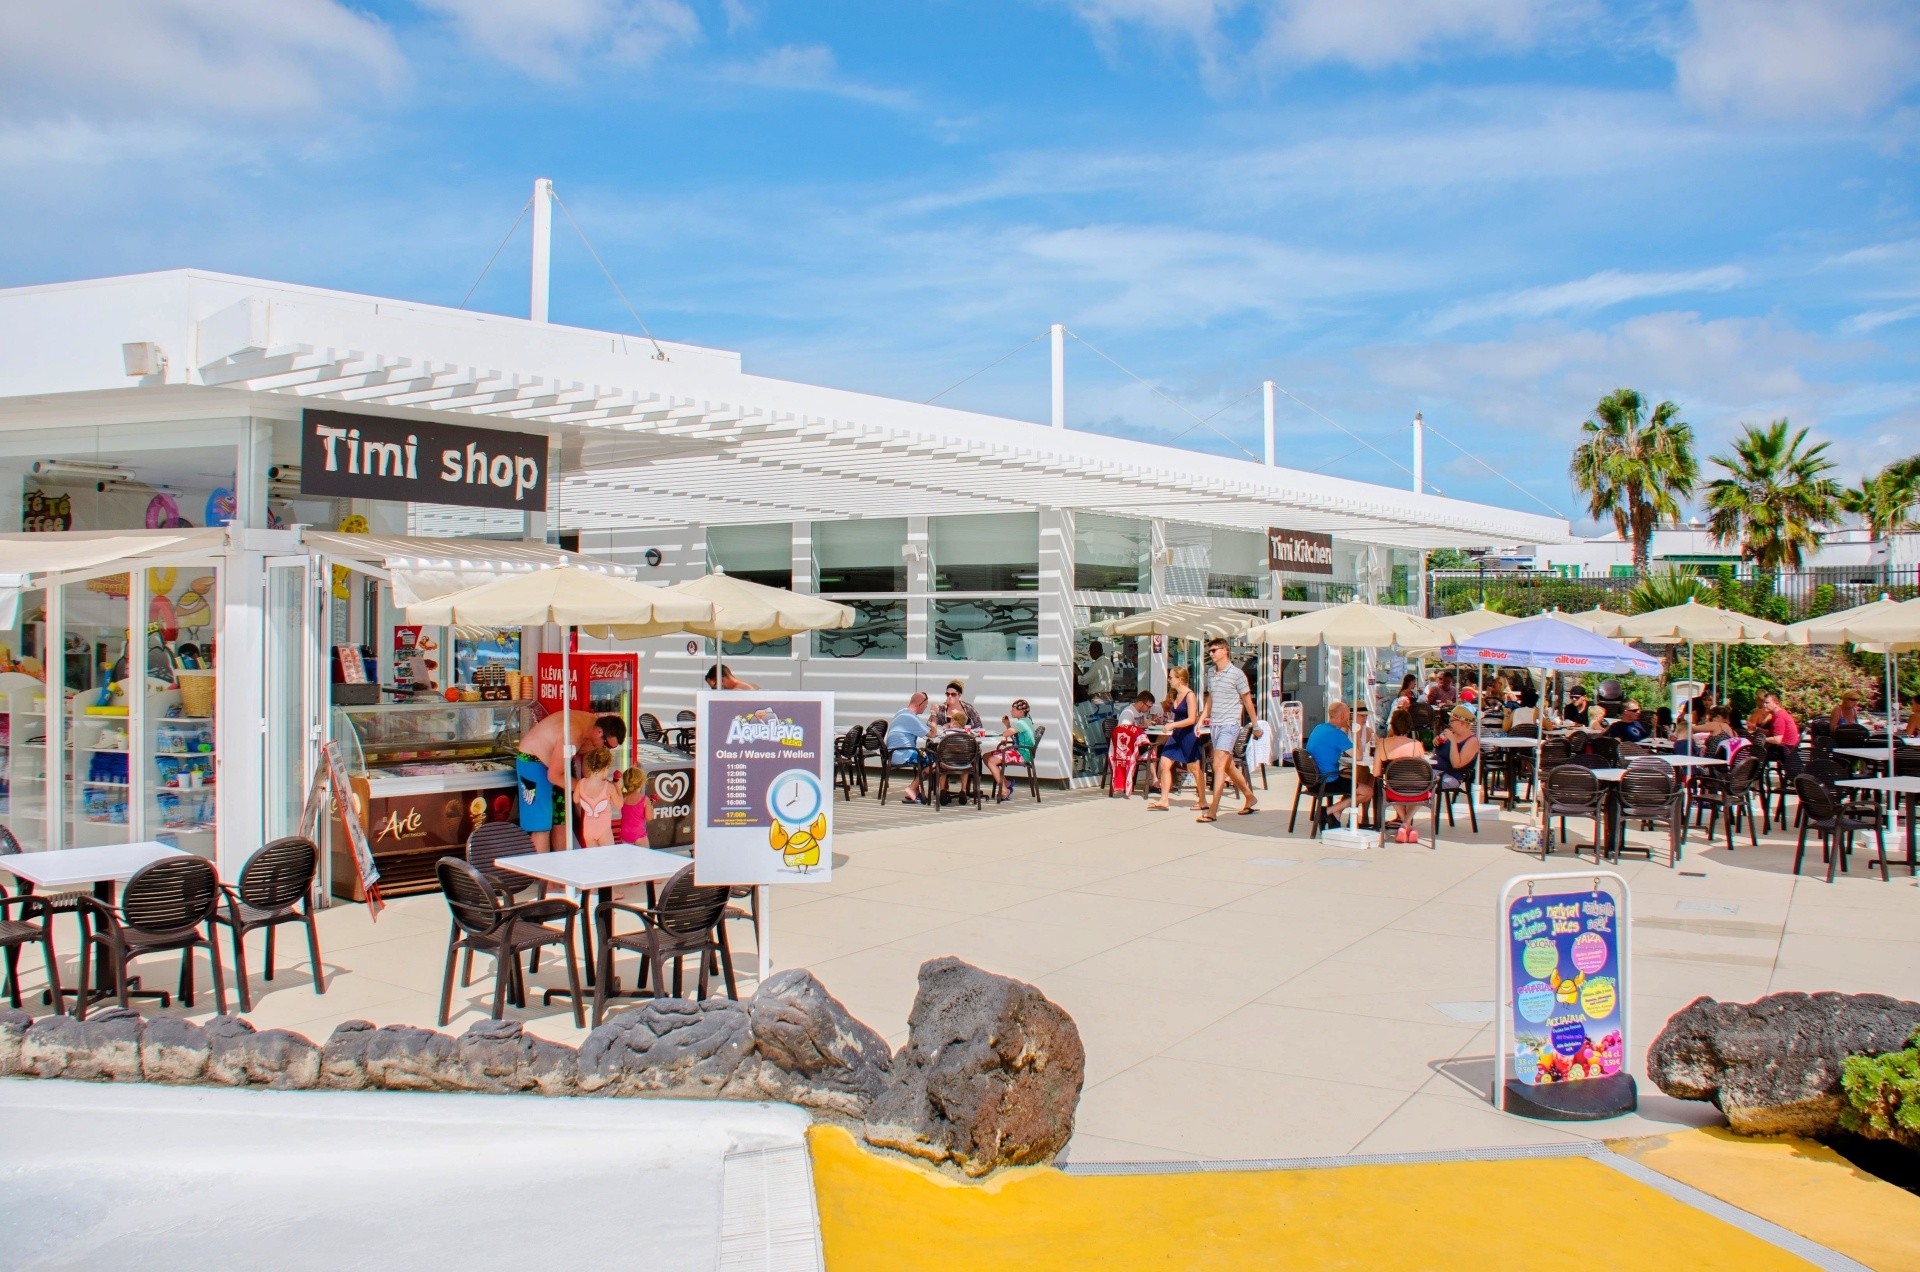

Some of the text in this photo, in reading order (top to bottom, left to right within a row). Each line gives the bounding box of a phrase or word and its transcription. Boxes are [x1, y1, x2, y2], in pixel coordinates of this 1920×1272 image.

[316, 424, 539, 501] Timi shop
[1271, 535, 1332, 565] Timi Kitchen
[1478, 649, 1508, 659] alltours
[1555, 655, 1590, 665] alltours
[541, 665, 577, 682] LLÉVALA
[541, 682, 577, 701] BIEN FÍA
[716, 749, 738, 759] Olas
[744, 749, 776, 759] Waves
[783, 749, 815, 759] Wellen
[653, 804, 690, 820] FRIGO
[377, 806, 423, 842] Arte
[1574, 933, 1602, 946] YAIZA
